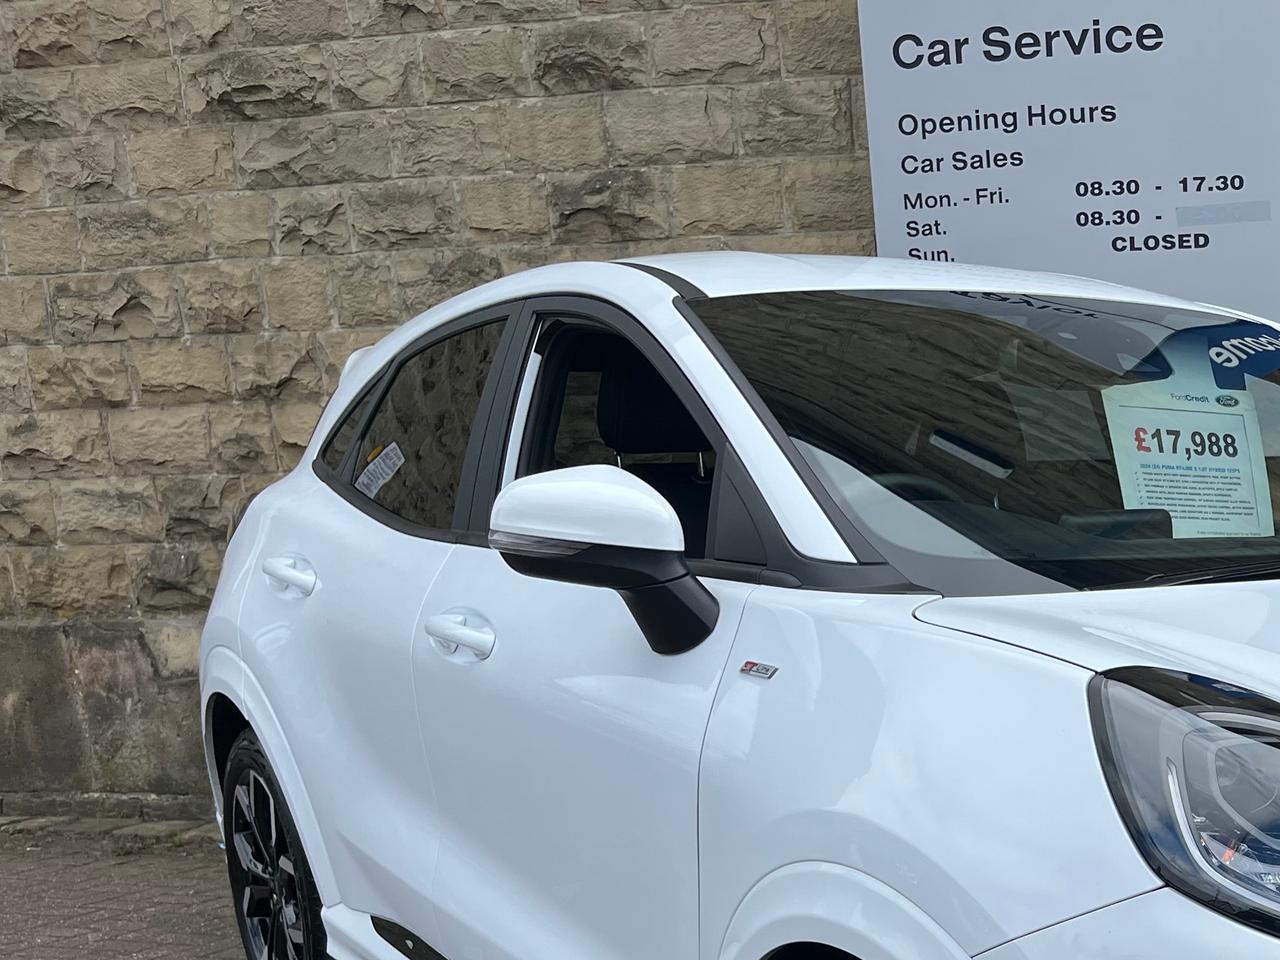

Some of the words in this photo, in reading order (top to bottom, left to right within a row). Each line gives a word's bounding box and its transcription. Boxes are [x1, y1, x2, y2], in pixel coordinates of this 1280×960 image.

[892, 33, 969, 69] Car
[982, 19, 1164, 62] Service
[898, 110, 1018, 139] Opening
[1027, 104, 1117, 127] Hours
[901, 155, 944, 174] Car
[952, 149, 1024, 171] Sales
[903, 193, 958, 210] Mon.
[975, 187, 1009, 205] Fri.
[1075, 179, 1140, 197] 08.30
[1178, 175, 1244, 193] 17.30
[906, 220, 947, 237] Sat.
[1076, 210, 1140, 227] 08.30
[908, 248, 955, 262] Sun.
[1111, 233, 1210, 252] CLOSED
[1134, 427, 1239, 461] £17,988
